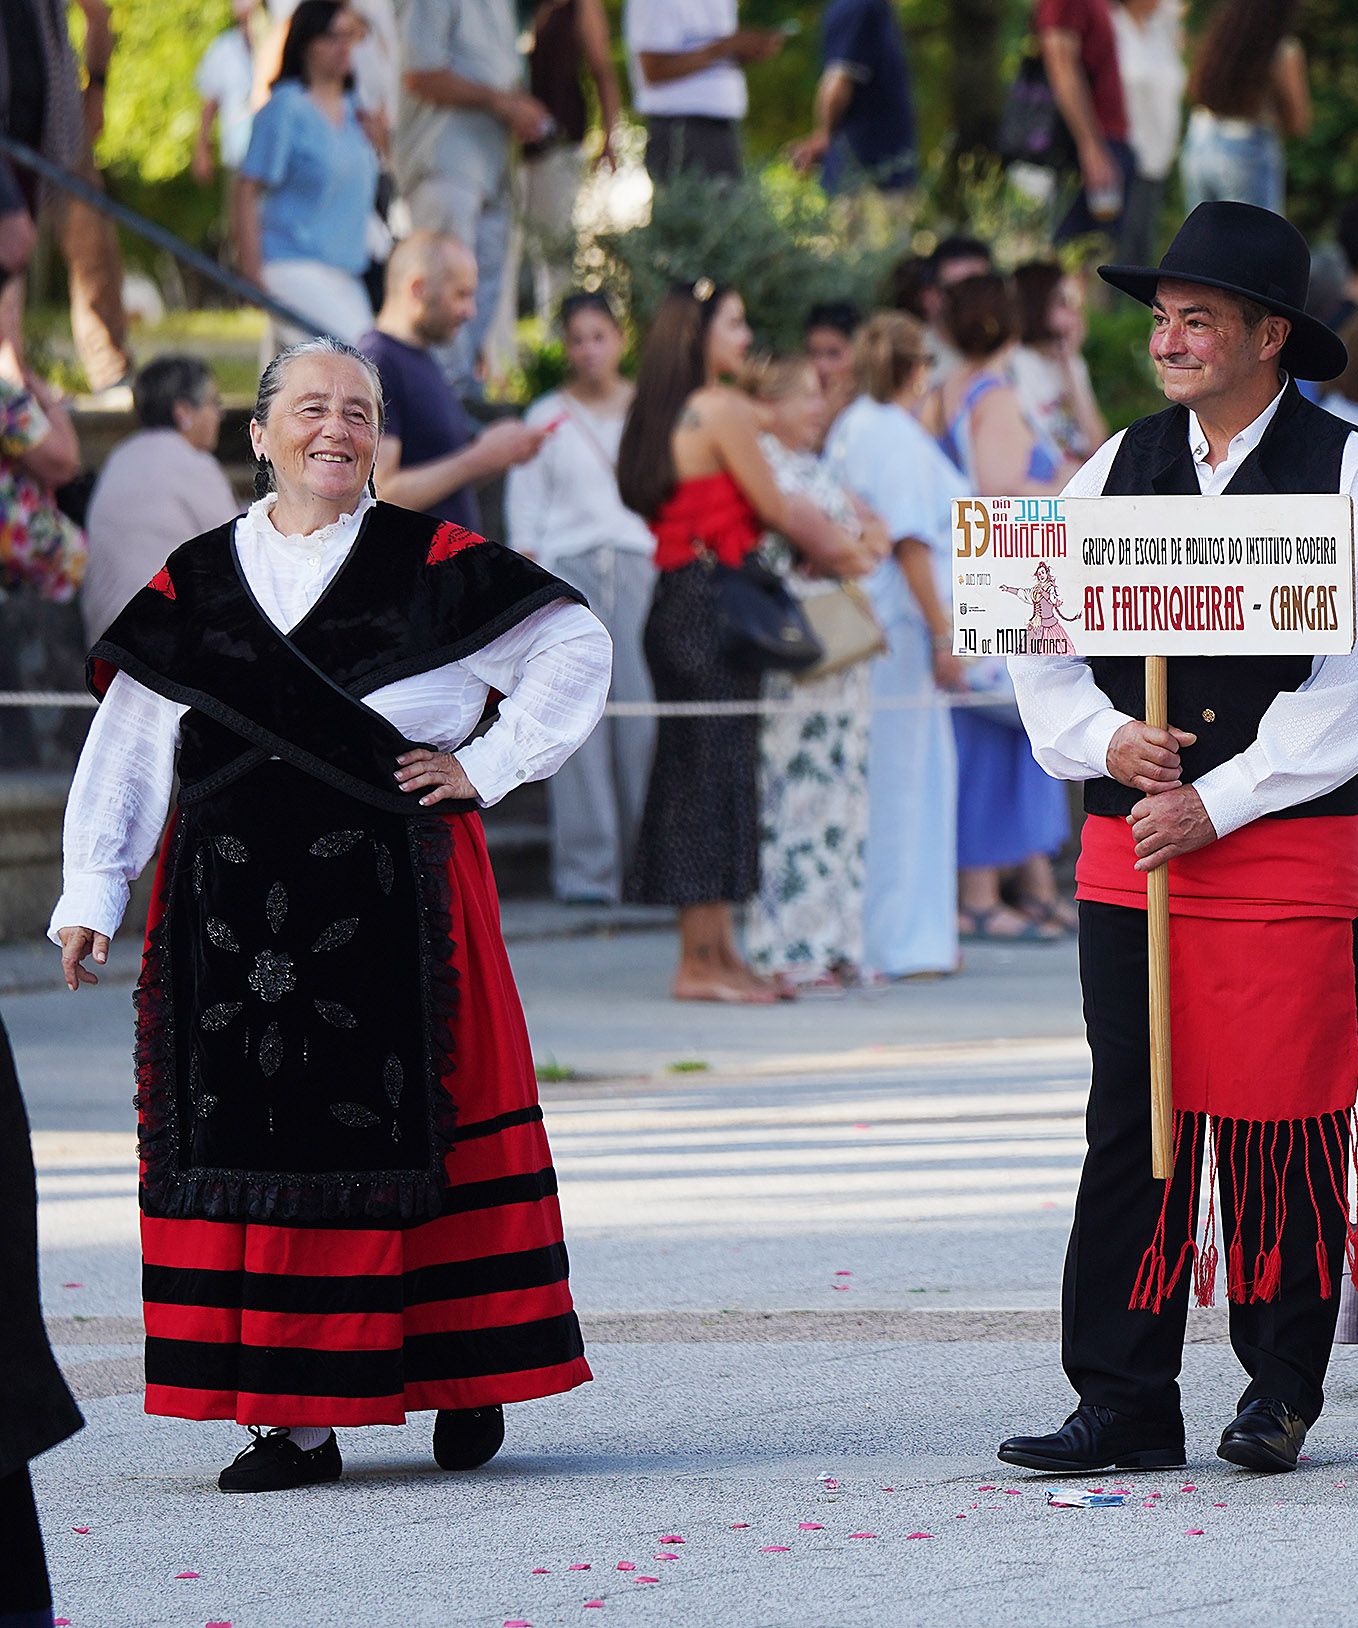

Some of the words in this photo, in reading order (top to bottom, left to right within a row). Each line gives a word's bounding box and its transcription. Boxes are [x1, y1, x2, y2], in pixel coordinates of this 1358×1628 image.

[1014, 500, 1066, 522] 2026
[957, 500, 990, 558] 53
[1082, 537, 1115, 565] GRUPO
[1118, 537, 1131, 565] DA
[1135, 537, 1167, 565] ESCOLA
[1171, 537, 1182, 565] DE
[1186, 537, 1225, 565] ADULTOS
[1228, 537, 1243, 565] DO
[1246, 537, 1292, 565] INSTITUTO
[1296, 537, 1337, 565] RODEIRA
[1084, 585, 1105, 632] AS
[1112, 585, 1245, 632] FALTRIQUEIRAS
[1269, 585, 1339, 633] CANGAS
[958, 628, 977, 654] 29
[981, 638, 992, 654] DE
[996, 628, 1028, 654] MAIO
